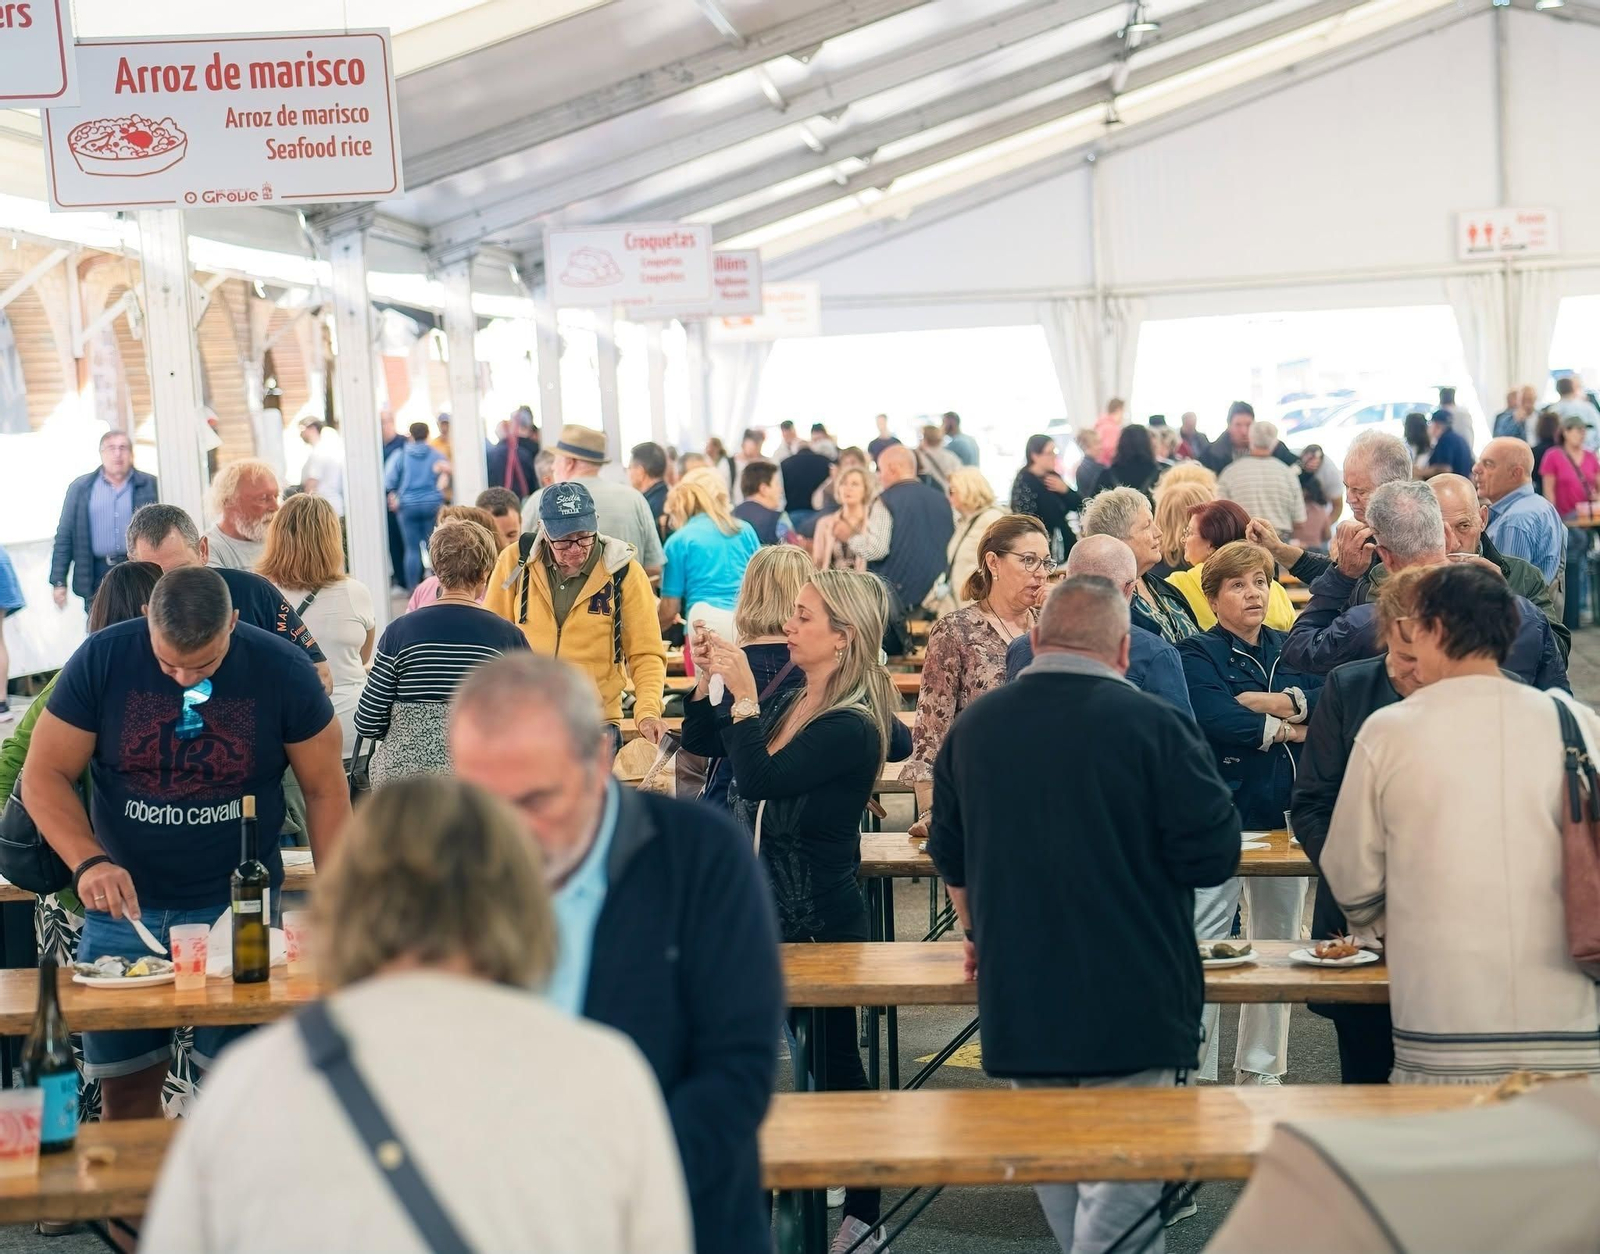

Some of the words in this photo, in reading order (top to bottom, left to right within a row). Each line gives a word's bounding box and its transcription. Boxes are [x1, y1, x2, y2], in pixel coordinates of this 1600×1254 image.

[115, 57, 198, 94] Arroz
[205, 52, 241, 91] de
[249, 50, 366, 89] marisco
[225, 107, 273, 128] Arroz
[277, 105, 297, 127] de
[302, 105, 370, 126] marisco
[266, 136, 337, 160] Seafood
[341, 136, 372, 157] rice
[624, 231, 697, 252] Croquetas
[587, 580, 614, 617] R
[124, 799, 184, 825] roberto
[187, 799, 241, 825] cavalli
